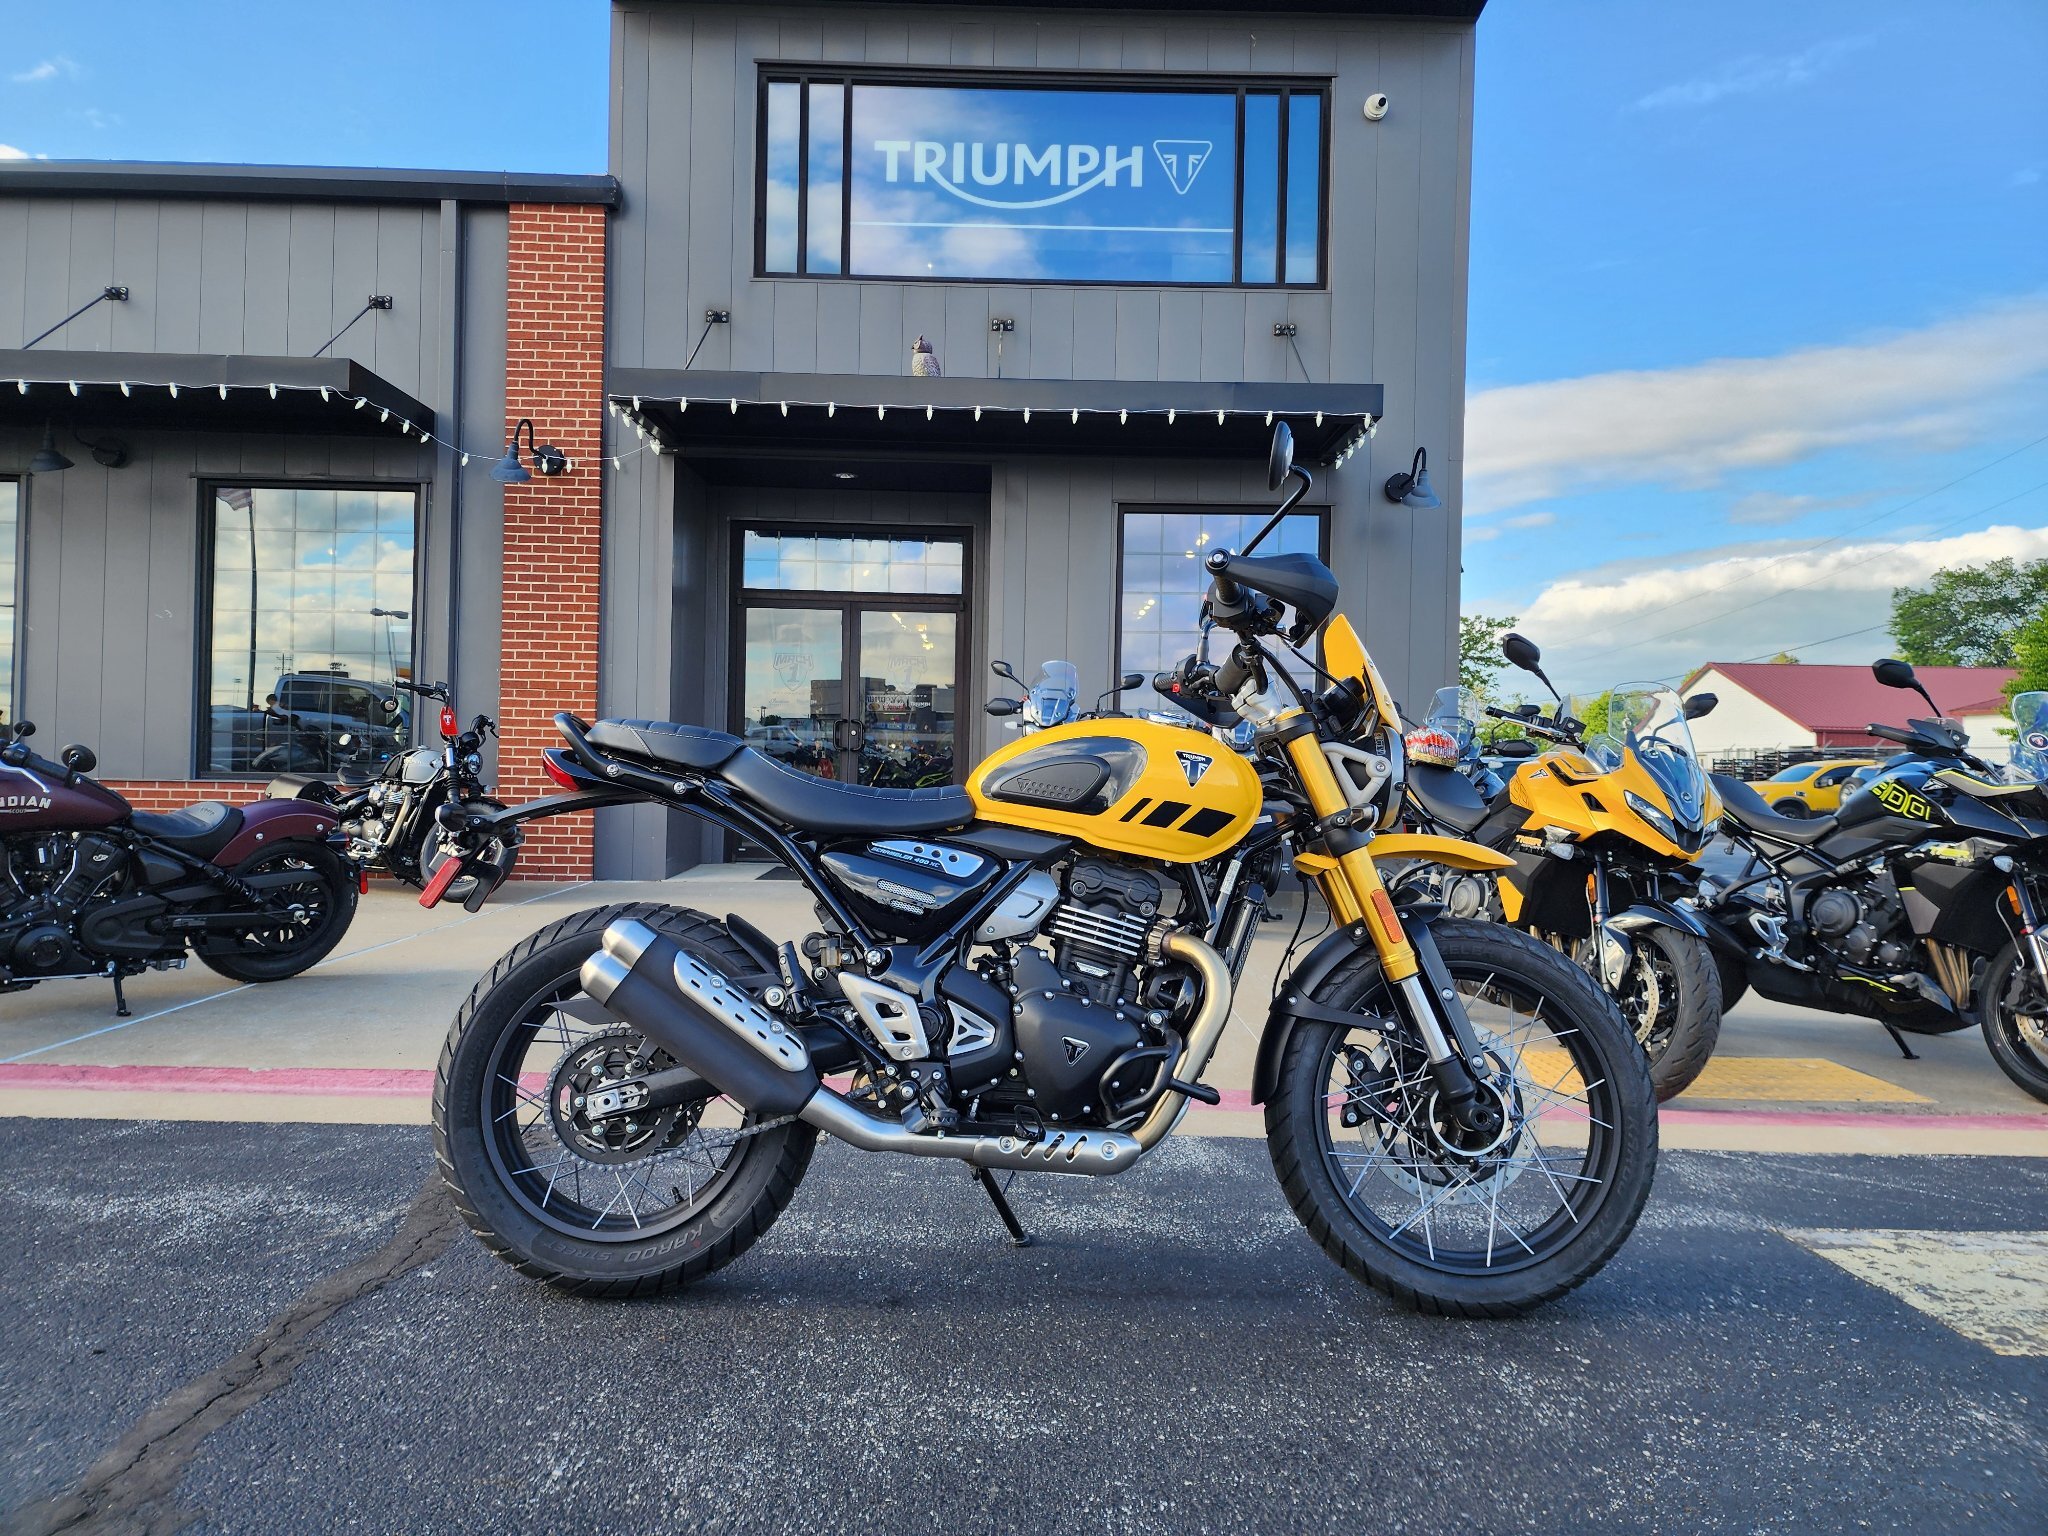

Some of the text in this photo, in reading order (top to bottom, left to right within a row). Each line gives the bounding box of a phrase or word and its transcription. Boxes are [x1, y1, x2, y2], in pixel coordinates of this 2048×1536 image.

[874, 140, 1143, 209] TRIUMPH
[775, 654, 812, 667] MACH
[889, 656, 926, 669] MACH
[1183, 753, 1206, 762] TRIUMPH
[871, 846, 913, 861] SCRAMBLER
[914, 855, 929, 865] 400
[546, 1224, 703, 1263] KAROO STREET
